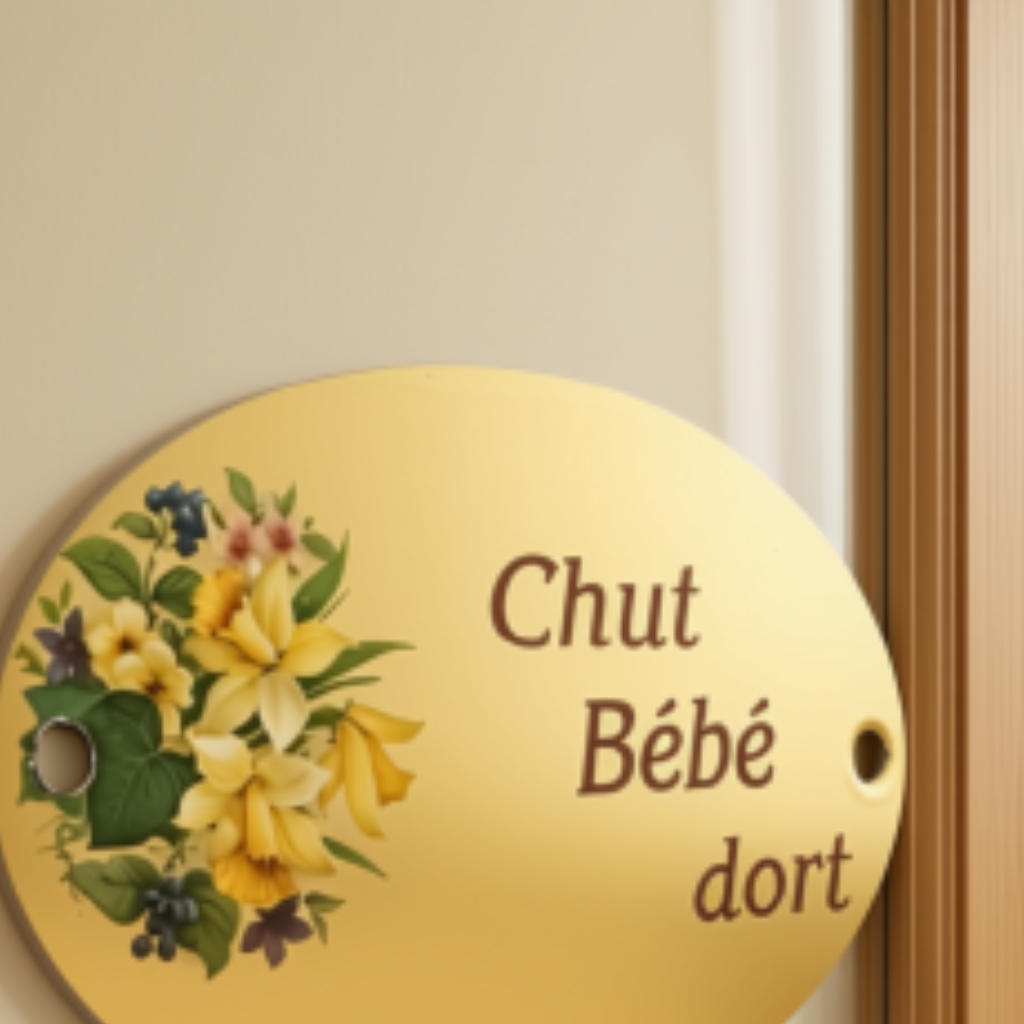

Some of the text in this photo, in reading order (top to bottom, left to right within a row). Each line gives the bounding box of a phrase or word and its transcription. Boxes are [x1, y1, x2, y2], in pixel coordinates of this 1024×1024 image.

[489, 553, 700, 649] Chut
[576, 696, 775, 797] Bébé
[692, 833, 853, 923] dort
